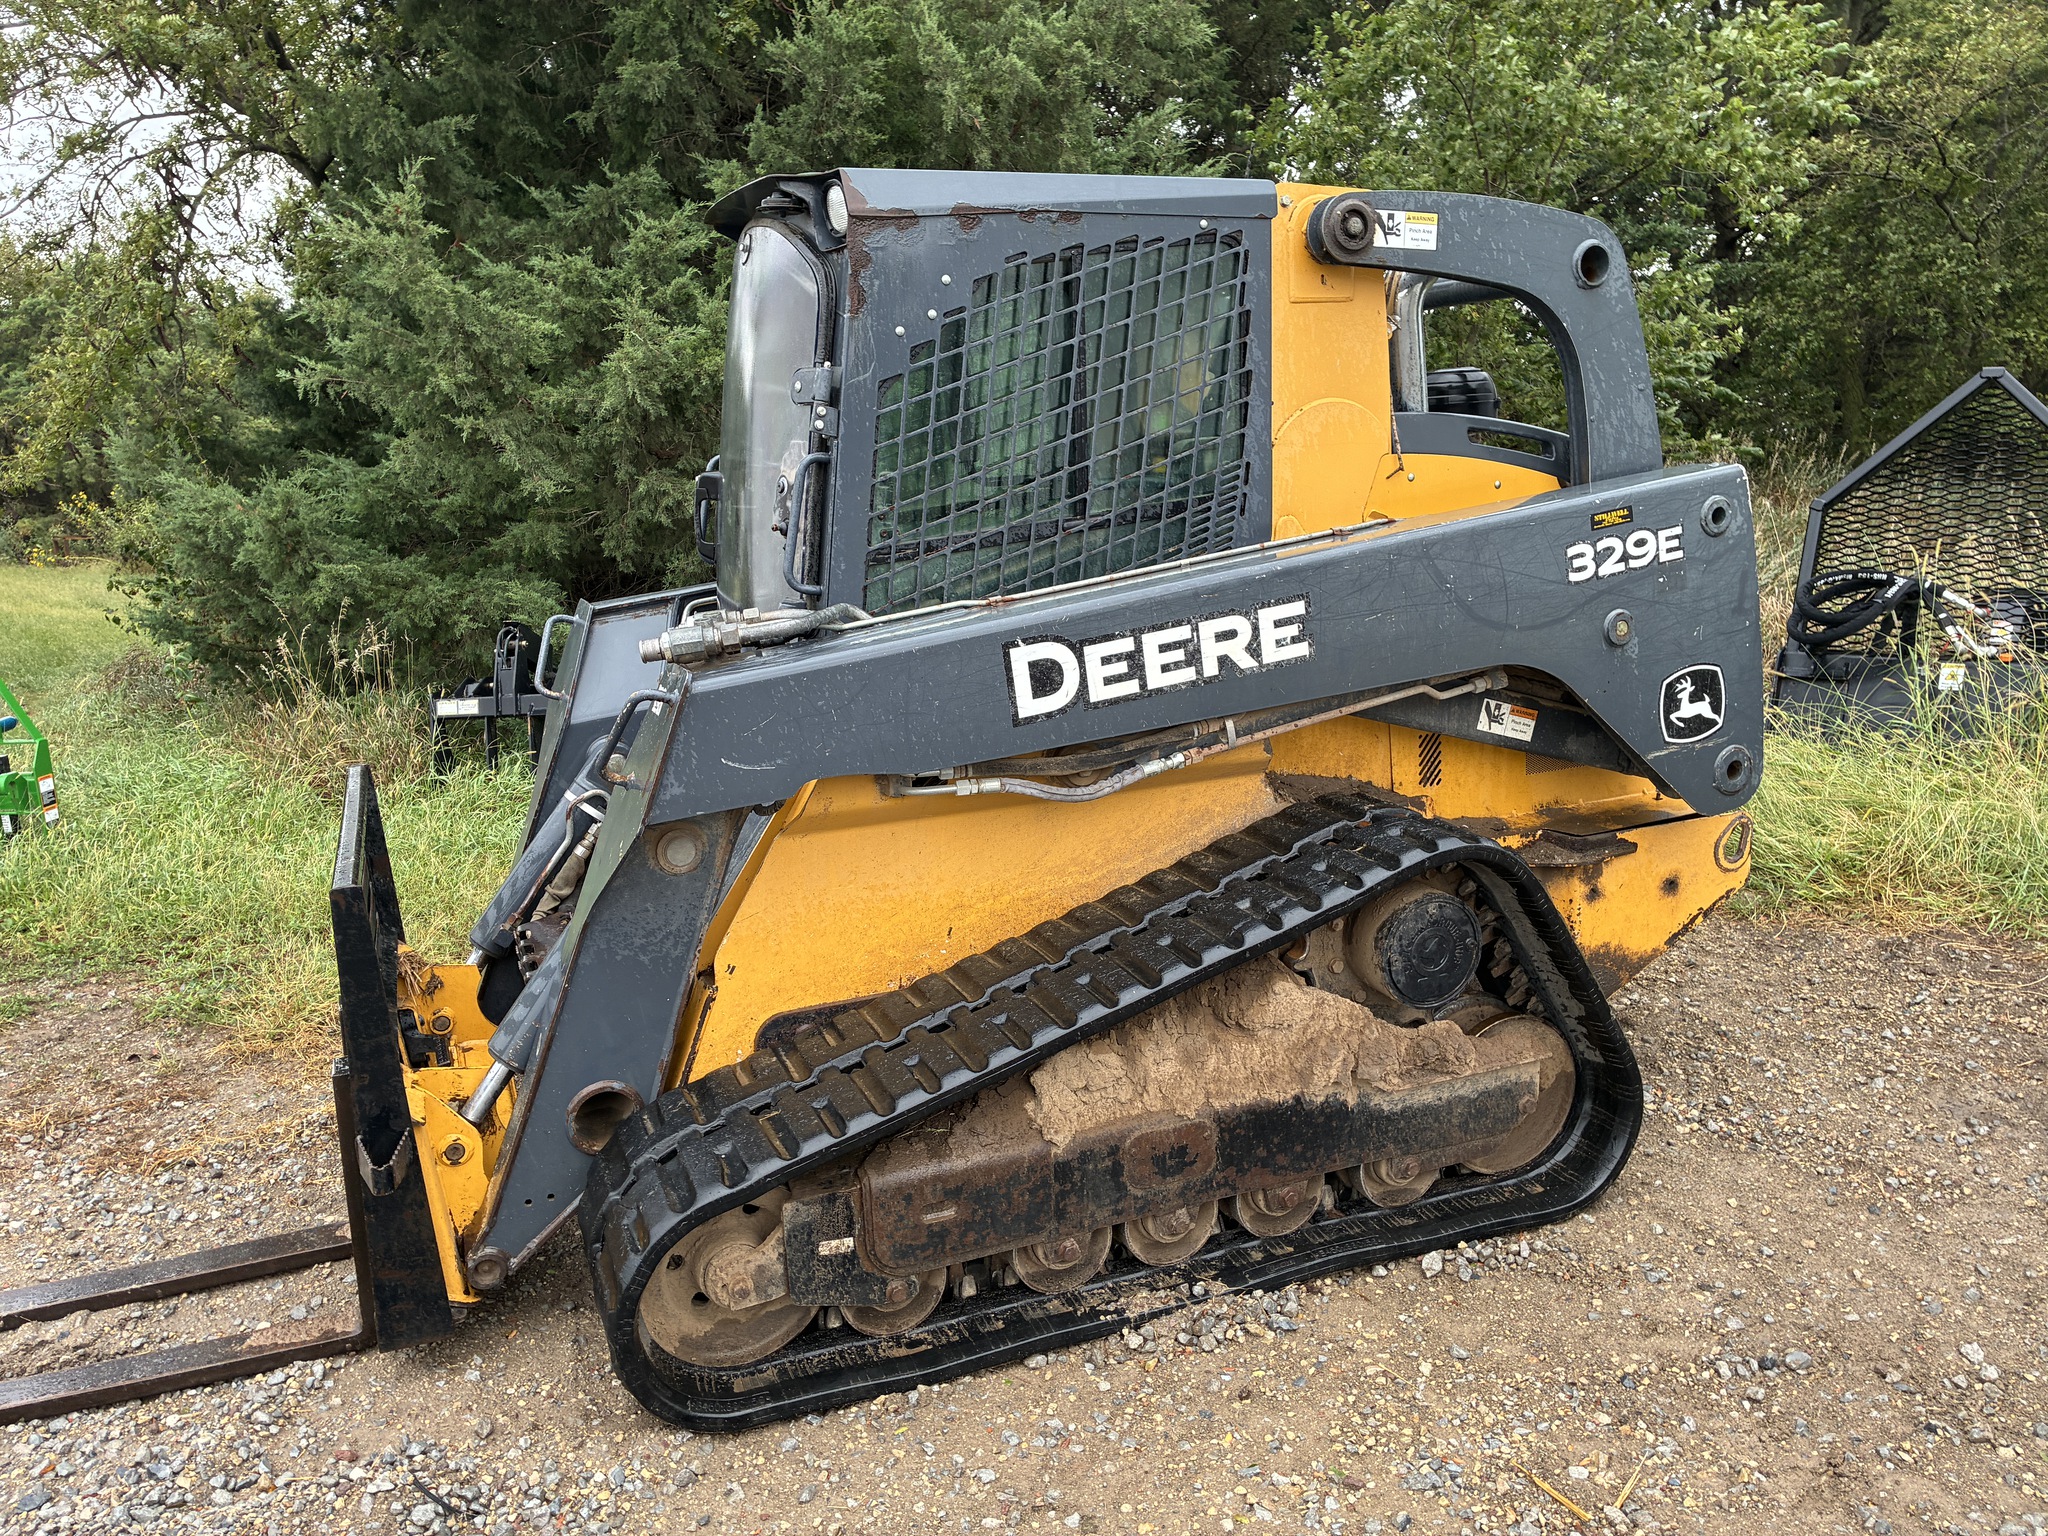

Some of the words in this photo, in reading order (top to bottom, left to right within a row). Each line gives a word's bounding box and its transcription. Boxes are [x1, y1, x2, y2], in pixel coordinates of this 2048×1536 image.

[1566, 525, 1685, 583] 329E
[1008, 599, 1310, 720] DEERE
[1515, 709, 1535, 717] WARNING
